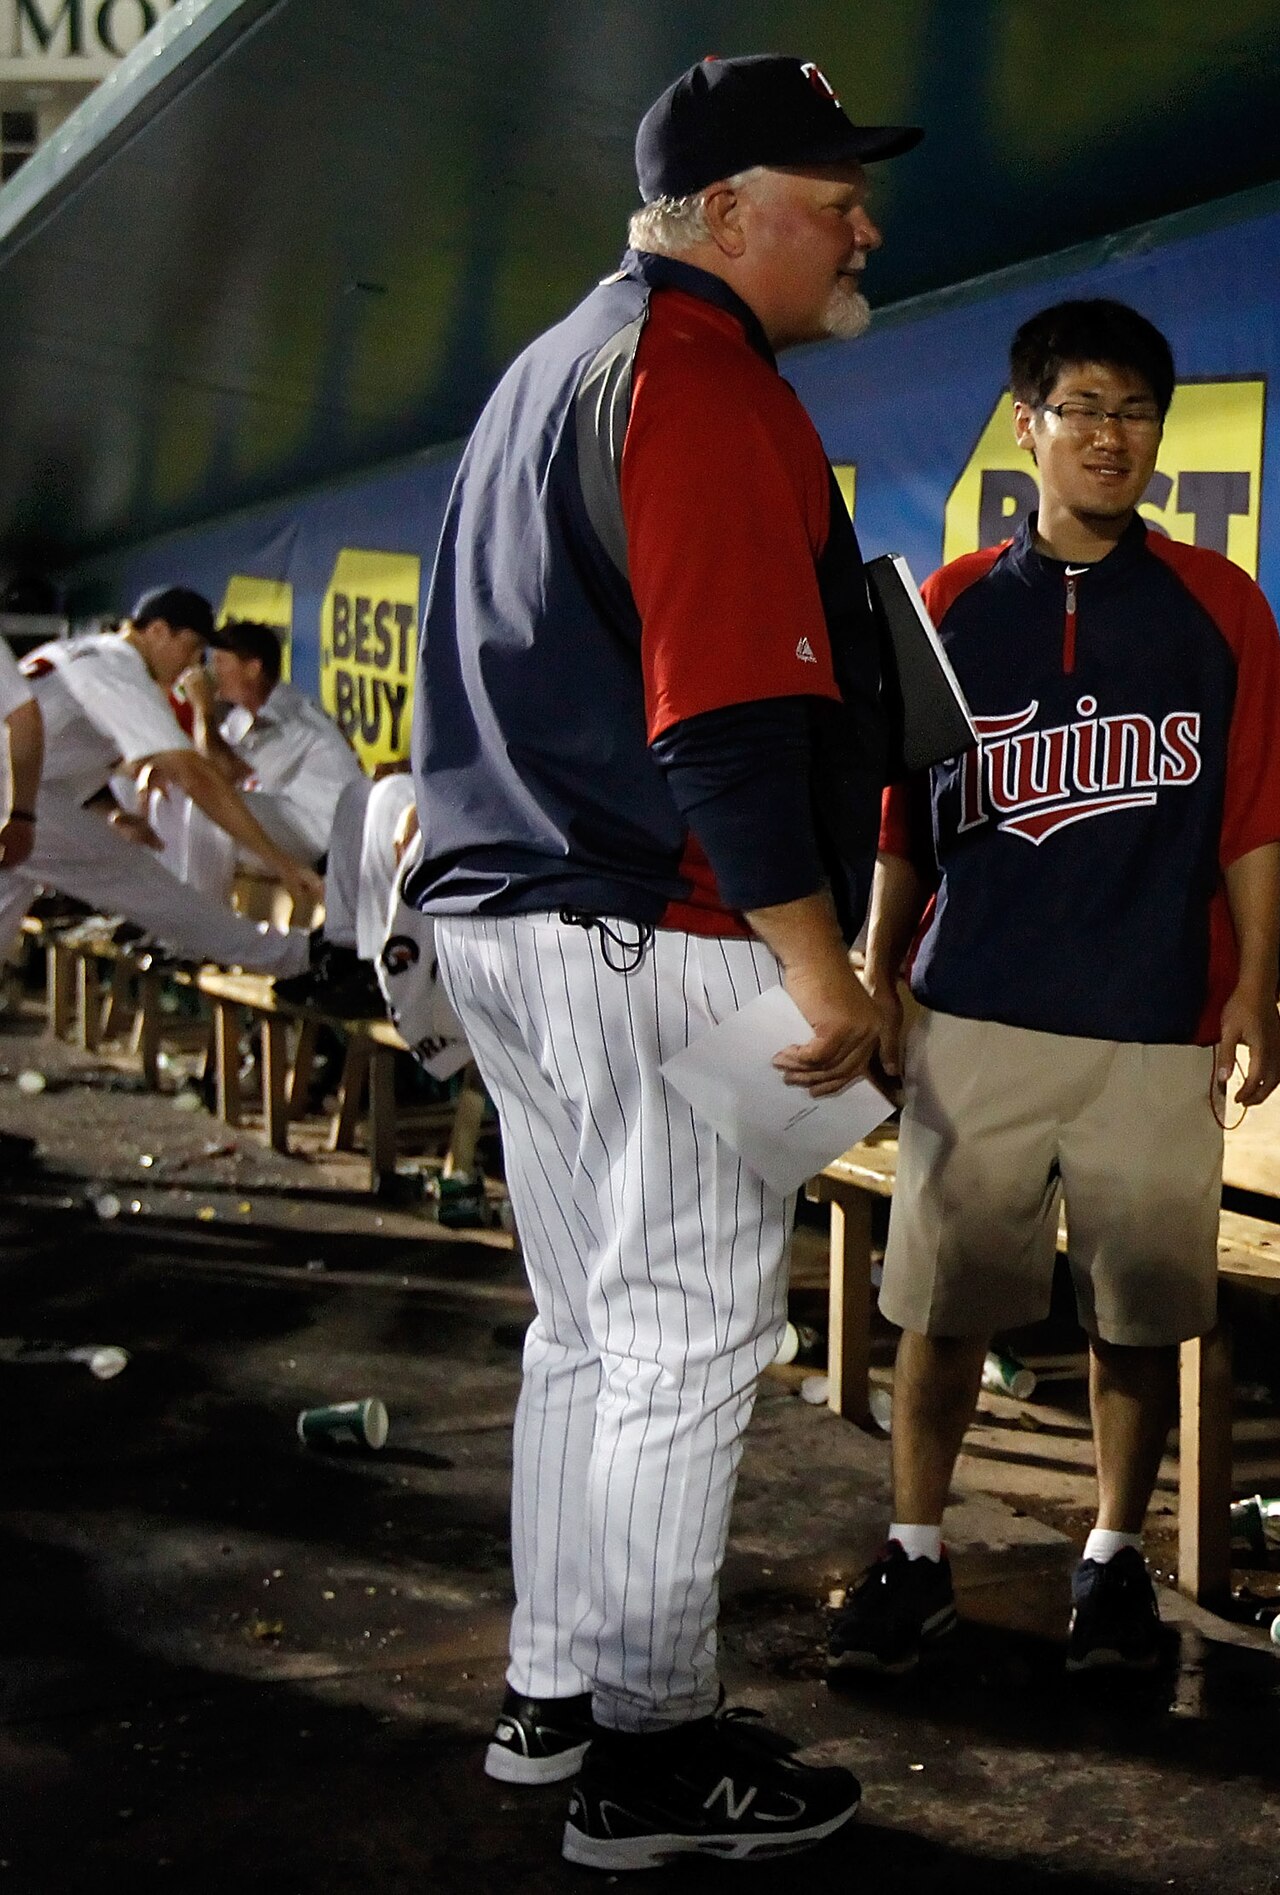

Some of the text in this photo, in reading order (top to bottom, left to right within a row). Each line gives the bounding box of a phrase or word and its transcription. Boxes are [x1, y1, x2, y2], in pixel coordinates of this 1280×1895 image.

[11, 0, 177, 58] MO
[333, 593, 413, 677] BEST
[336, 670, 408, 752] BUY
[957, 695, 1201, 835] Twins
